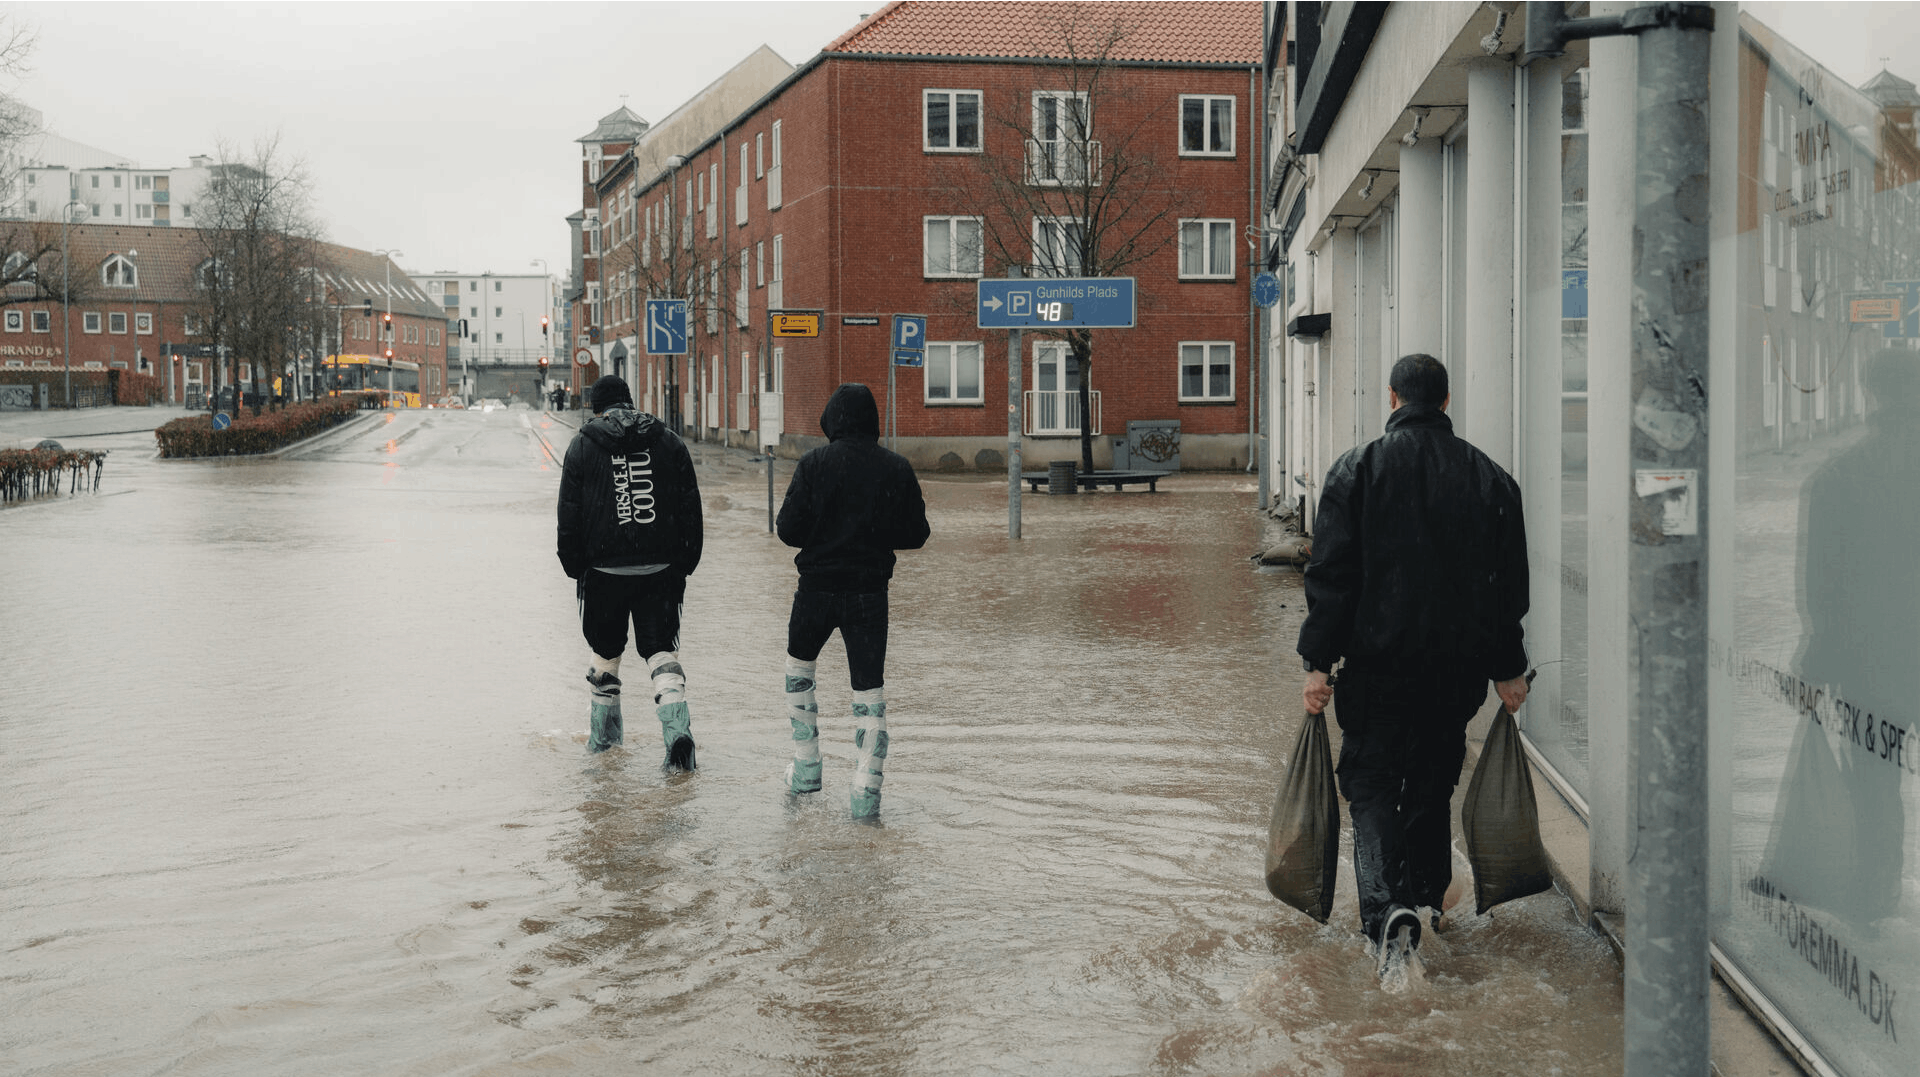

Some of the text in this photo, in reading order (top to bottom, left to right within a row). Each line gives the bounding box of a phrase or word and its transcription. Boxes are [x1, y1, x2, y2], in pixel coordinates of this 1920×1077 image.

[1013, 295, 1026, 312] P
[1036, 286, 1118, 298] Gunhilds Plads
[1037, 302, 1062, 321] 48
[901, 321, 918, 345] P
[612, 469, 632, 525] VERSACE
[628, 448, 656, 524] COUTU
[1864, 712, 1876, 754] &
